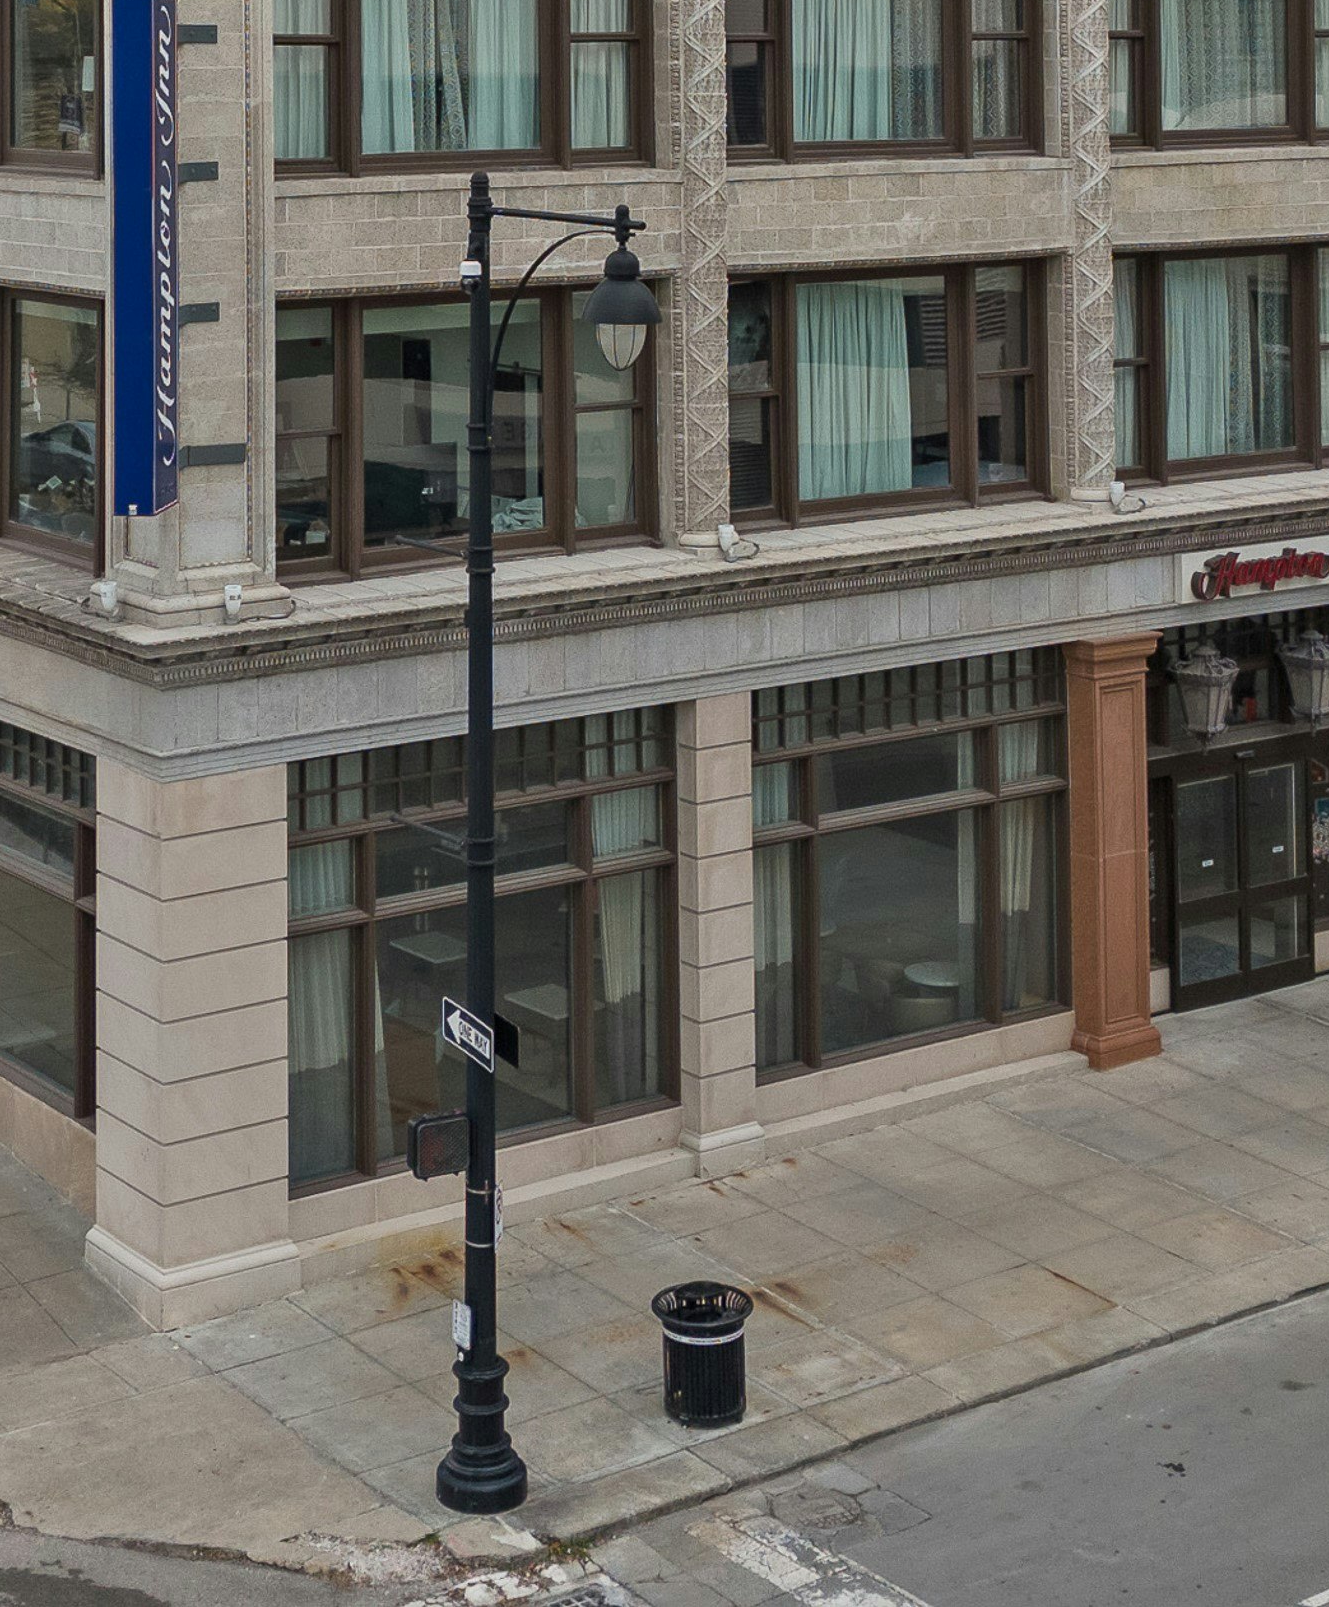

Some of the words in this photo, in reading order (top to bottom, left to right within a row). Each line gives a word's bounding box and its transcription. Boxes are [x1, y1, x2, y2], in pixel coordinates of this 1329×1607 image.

[155, 5, 175, 146] Inn
[157, 160, 176, 466] Hampton
[458, 1020, 473, 1043] ONE
[474, 1031, 488, 1055] WAY
